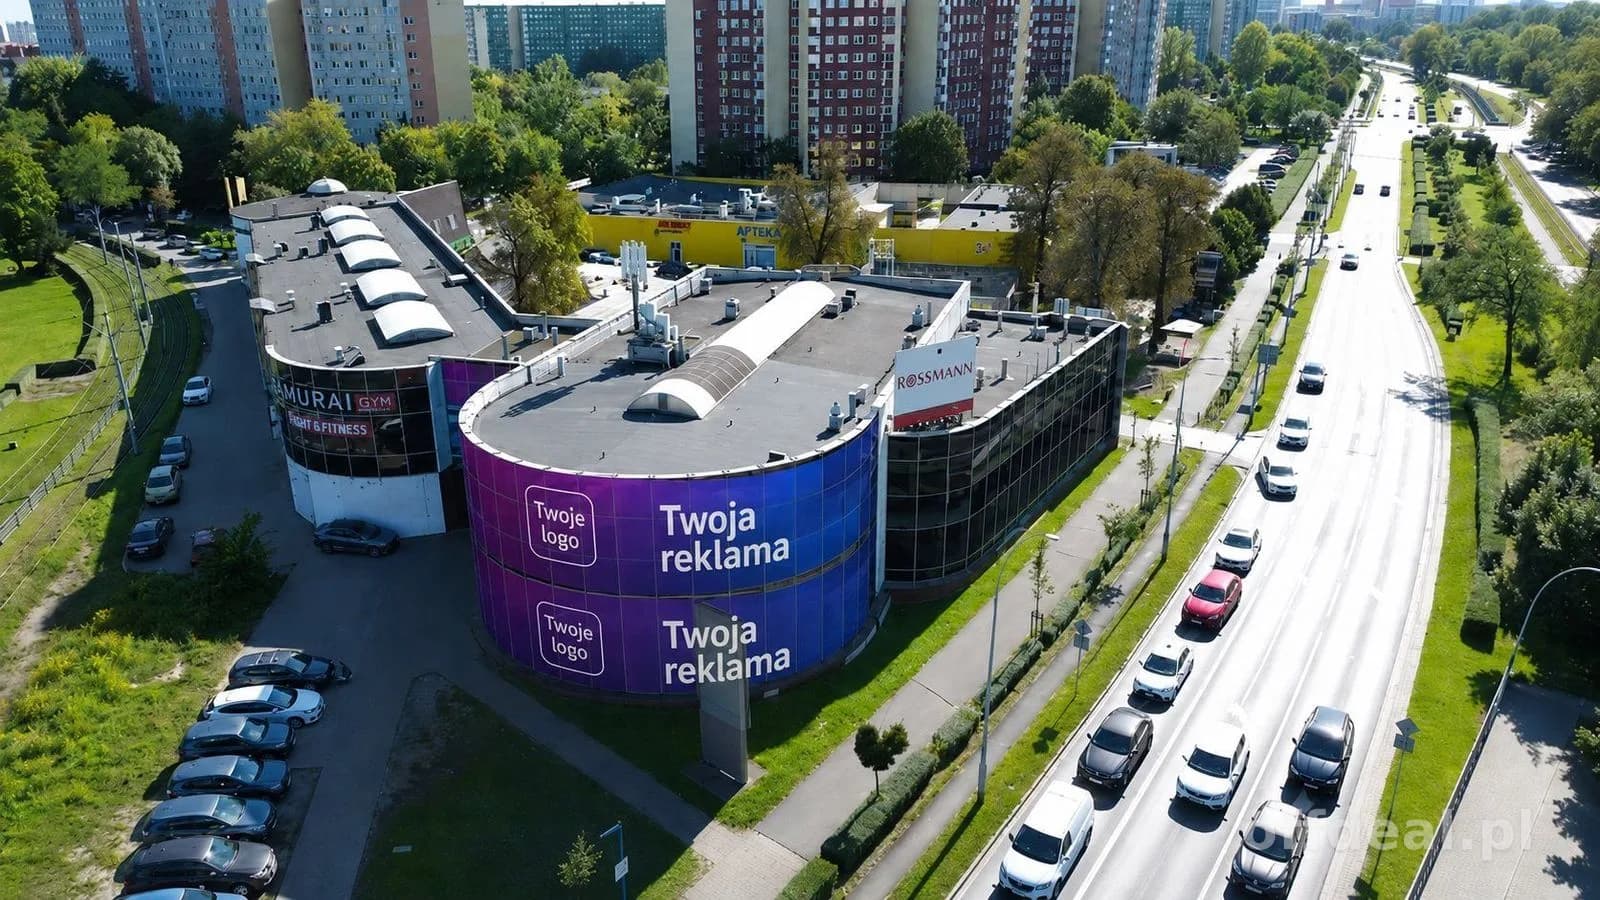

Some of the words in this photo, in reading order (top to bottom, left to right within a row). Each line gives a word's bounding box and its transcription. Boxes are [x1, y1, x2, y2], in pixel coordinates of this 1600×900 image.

[736, 225, 782, 238] APTEKA
[897, 361, 973, 390] ROSSMANN
[359, 396, 392, 408] GYM
[322, 422, 367, 436] FITNESS
[533, 500, 586, 529] Twoje
[659, 501, 756, 541] Twoja
[541, 524, 580, 551] logo
[661, 537, 790, 573] reklama
[543, 614, 594, 641] Twoje
[662, 615, 757, 654] Twoja
[551, 636, 588, 661] logo
[665, 647, 791, 685] reklama
